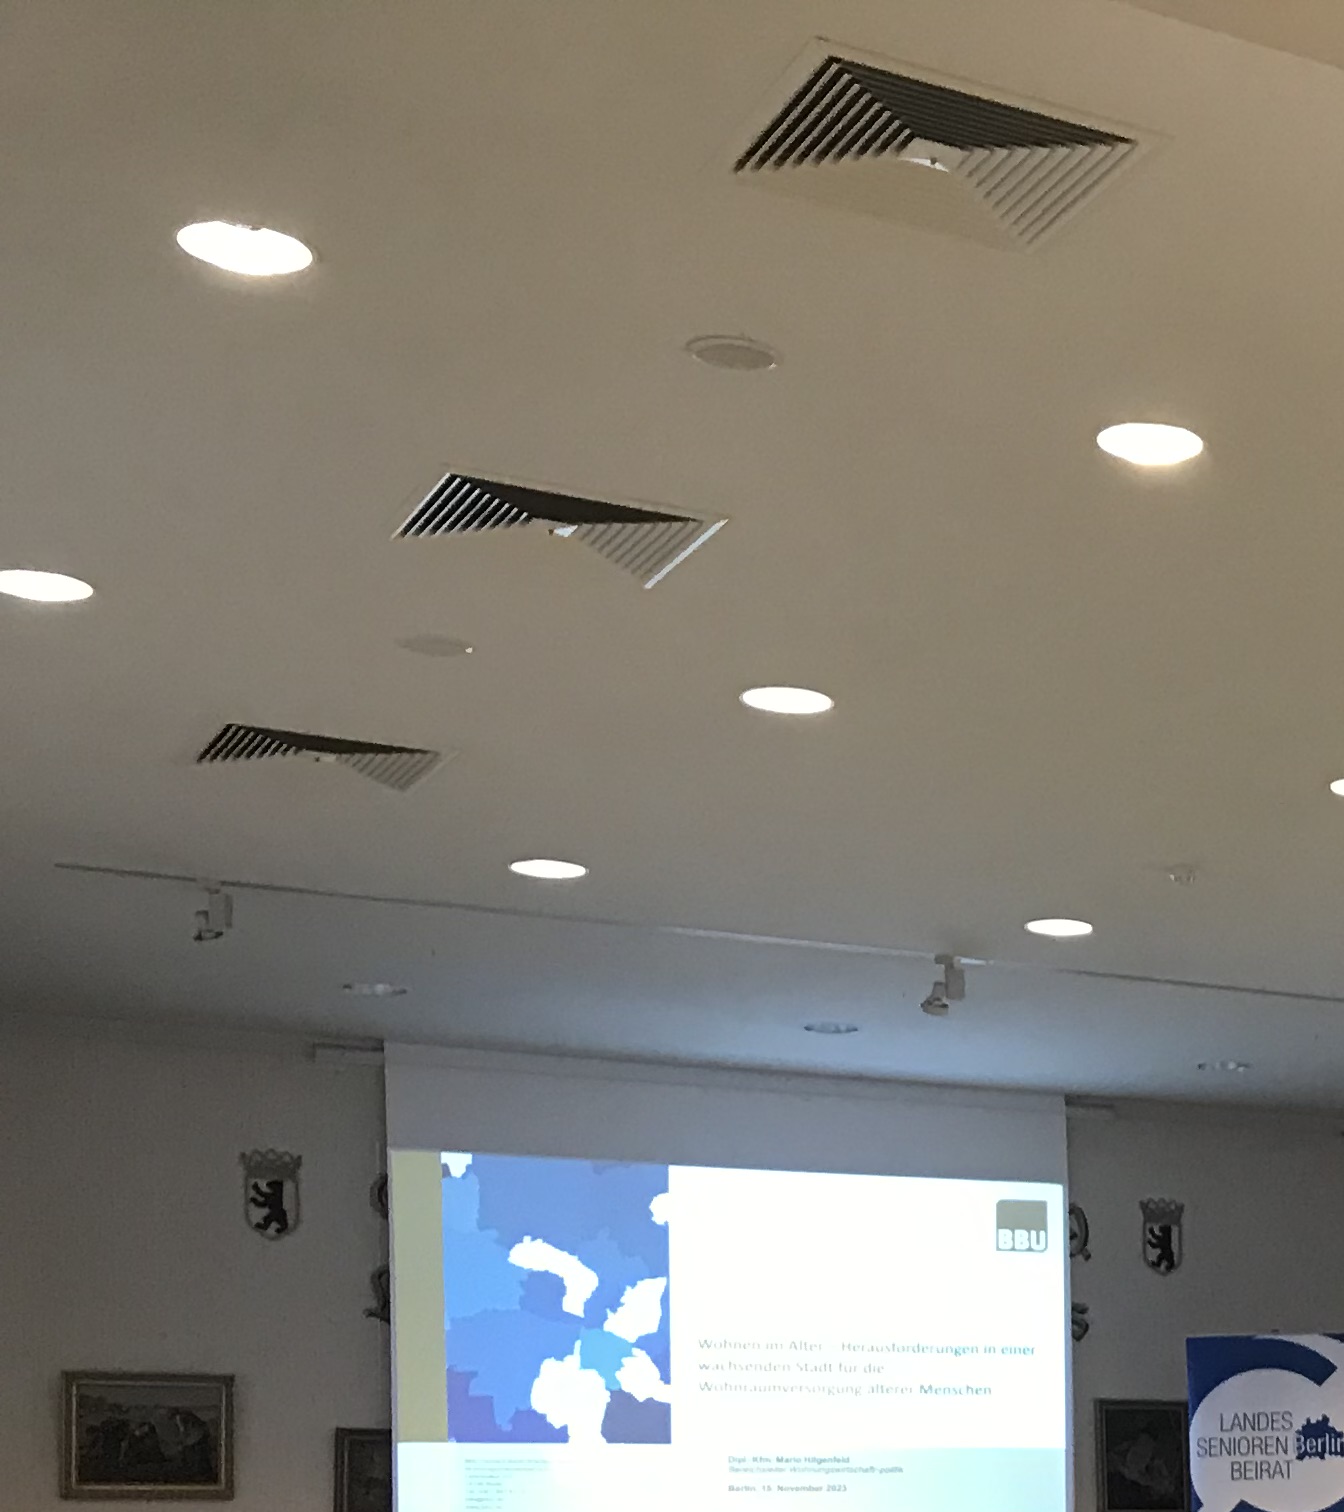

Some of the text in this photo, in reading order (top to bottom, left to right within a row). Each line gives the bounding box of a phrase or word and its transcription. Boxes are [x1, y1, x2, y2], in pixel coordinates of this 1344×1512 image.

[998, 1228, 1046, 1250] BBU
[698, 1339, 760, 1351] Wohnen
[766, 1341, 783, 1351] im
[984, 1344, 996, 1354] in
[1001, 1344, 1035, 1355] einer
[698, 1361, 791, 1372] wachsenden
[863, 1363, 885, 1374] die
[919, 1384, 992, 1395] Menschen
[1220, 1410, 1293, 1433] LANDES
[1197, 1435, 1289, 1458] SENIOREN
[1231, 1459, 1293, 1481] BEIRAT
